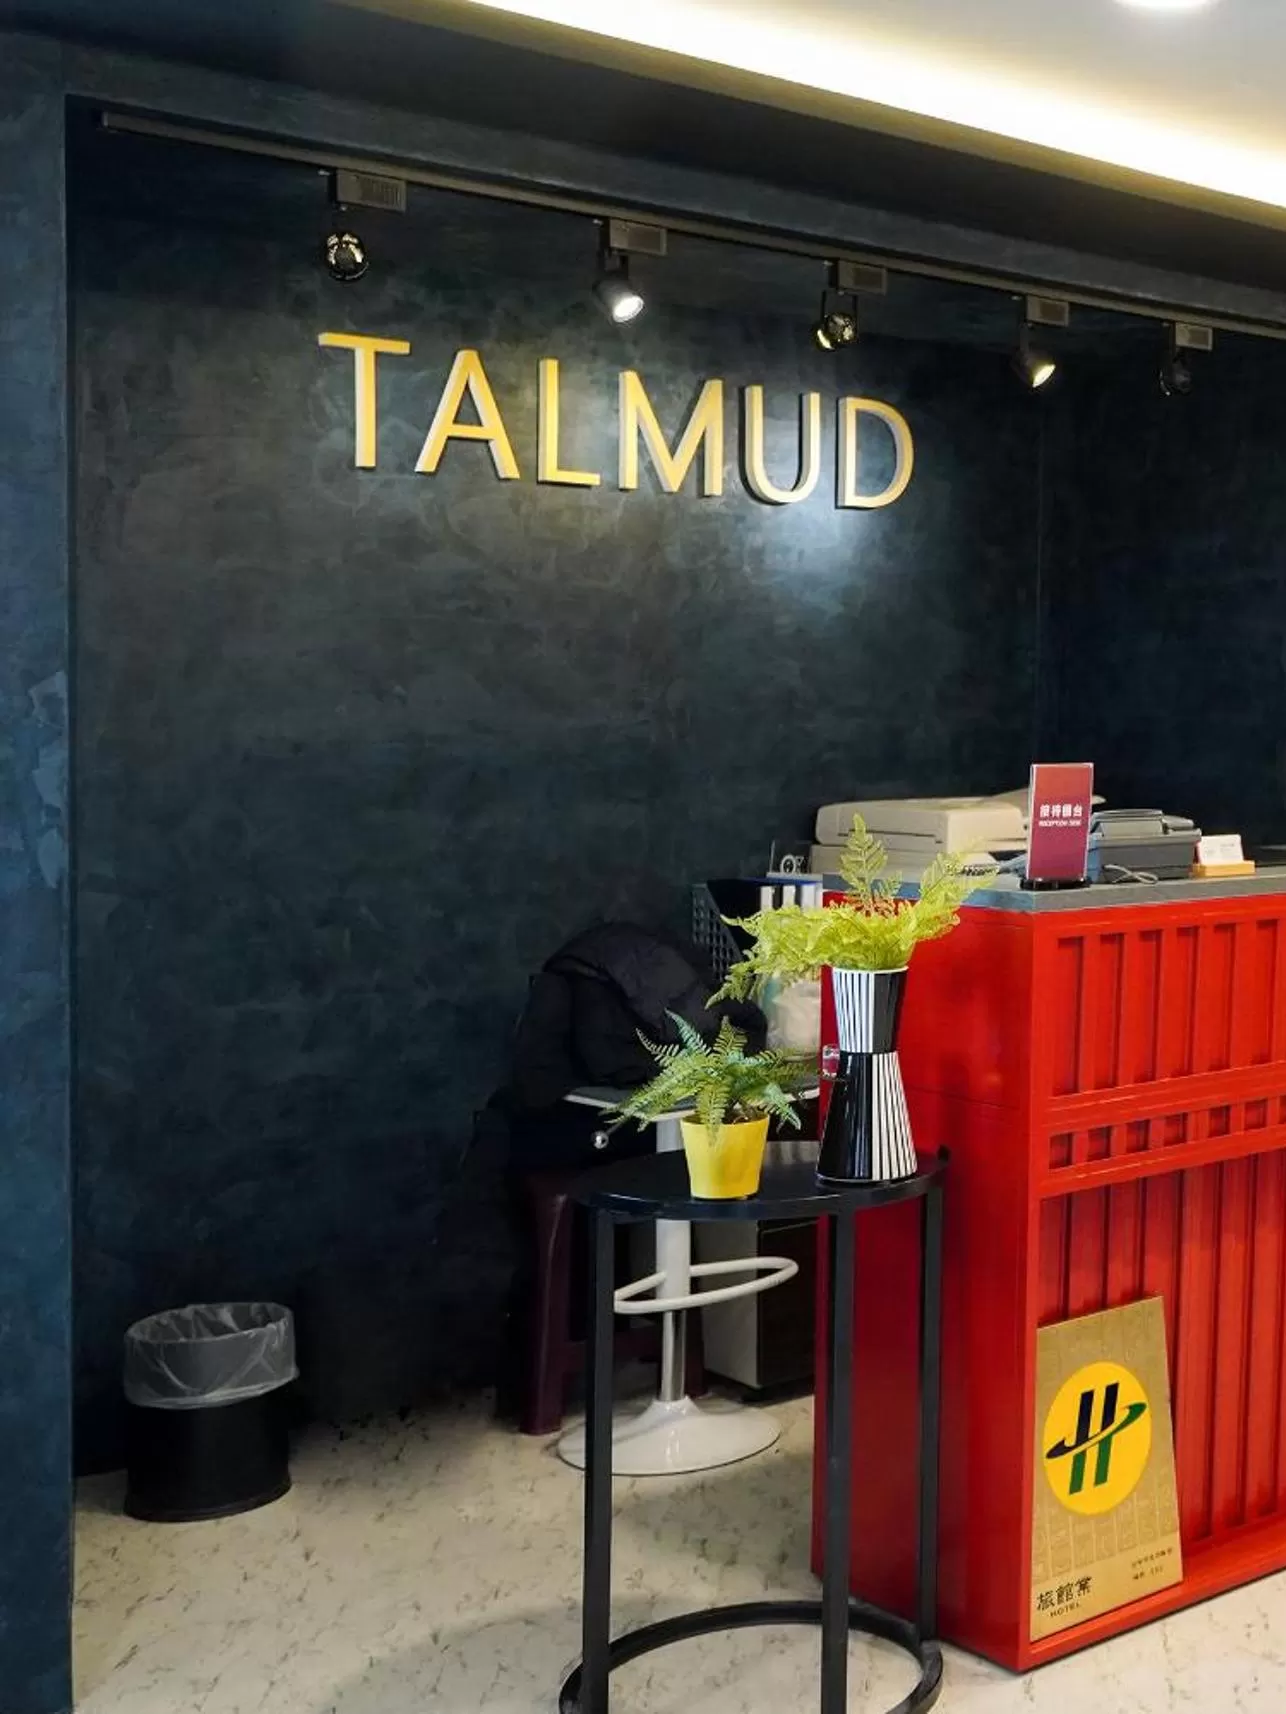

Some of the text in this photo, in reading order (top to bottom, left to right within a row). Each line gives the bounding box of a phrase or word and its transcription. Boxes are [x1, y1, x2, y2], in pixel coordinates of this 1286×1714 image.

[318, 331, 915, 509] TALMUD
[1036, 1576, 1092, 1611] 旅館業
[1050, 1601, 1079, 1617] HOTEL
